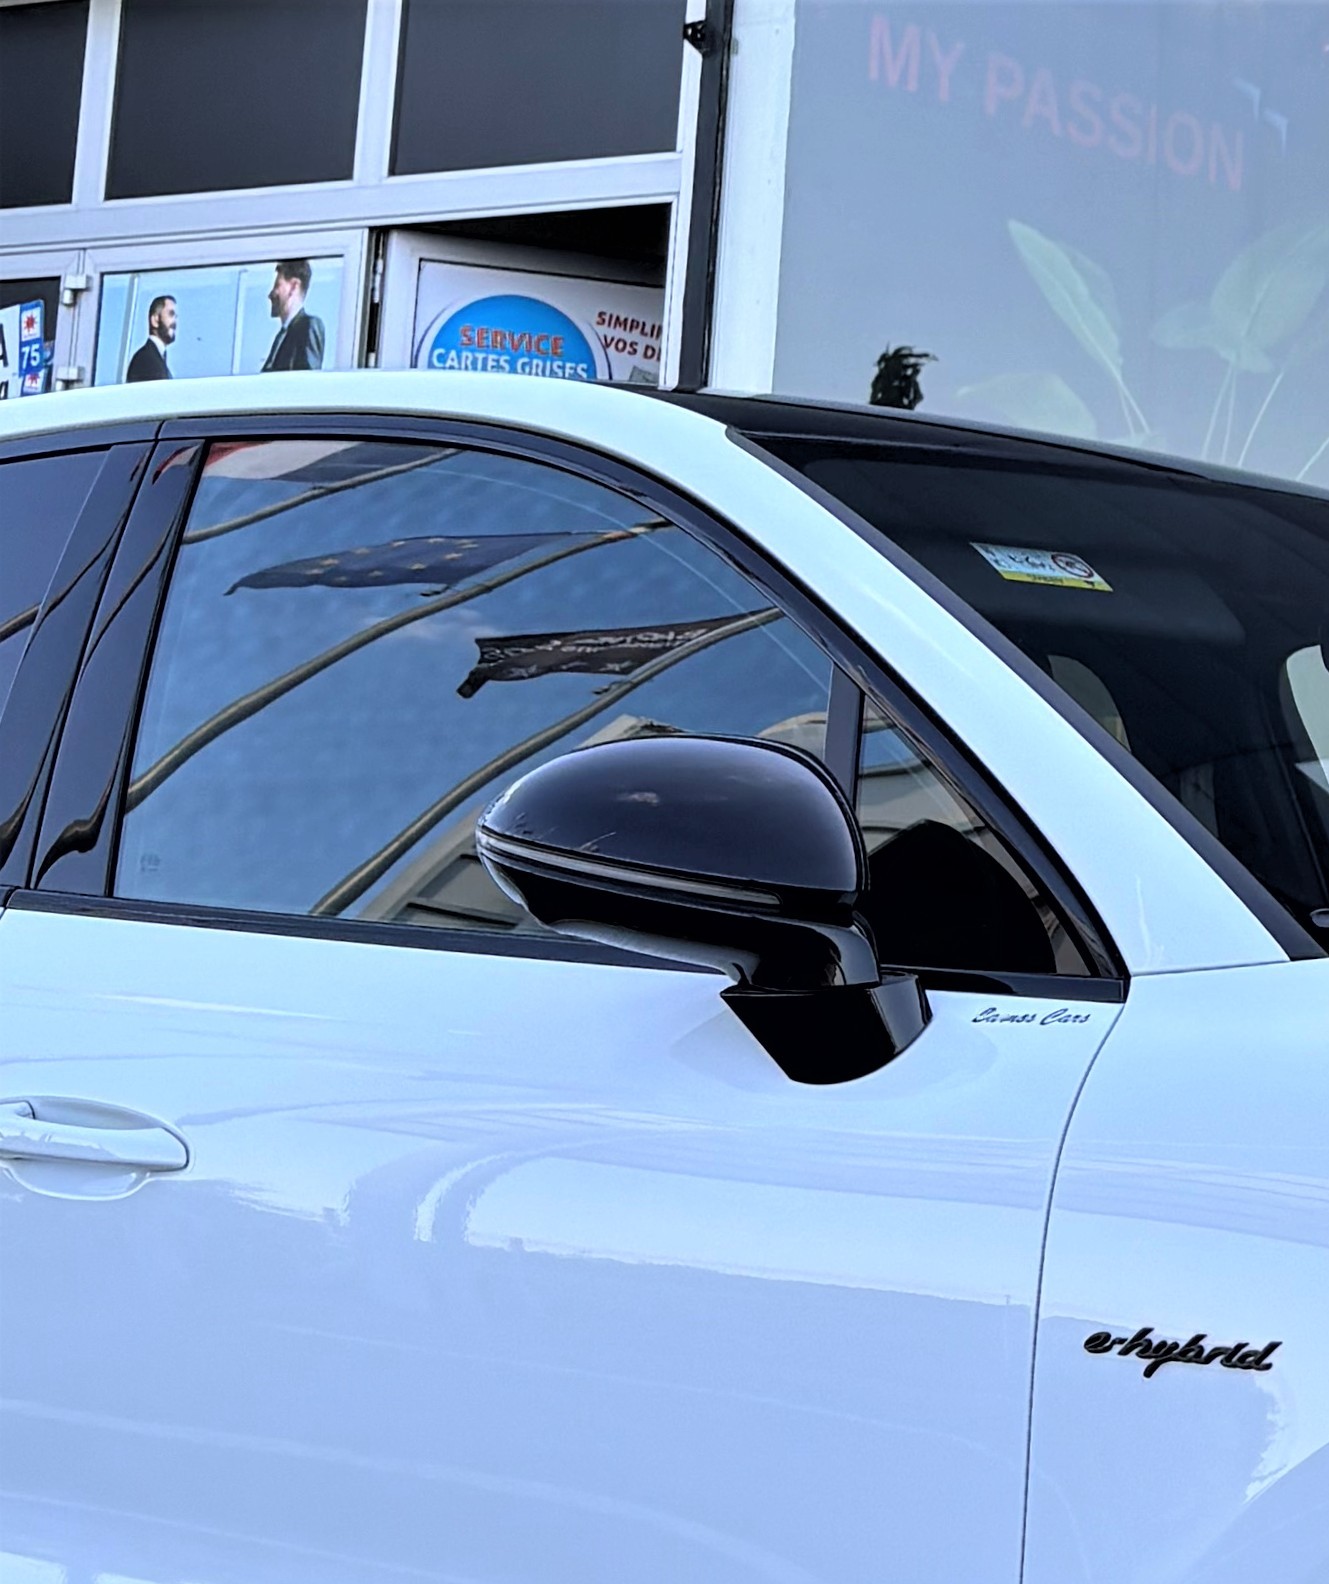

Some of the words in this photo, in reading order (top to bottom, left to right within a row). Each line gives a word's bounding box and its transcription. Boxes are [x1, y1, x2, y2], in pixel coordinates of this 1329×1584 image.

[868, 13, 965, 101] MY
[984, 51, 1245, 191] PASSION
[459, 324, 565, 357] SERVICE
[603, 334, 639, 355] VOS
[21, 343, 40, 370] 75
[432, 348, 510, 373] CARTES
[516, 357, 588, 379] GRISES
[1039, 1007, 1091, 1026] Cars
[1083, 1327, 1283, 1378] e-hybrid
